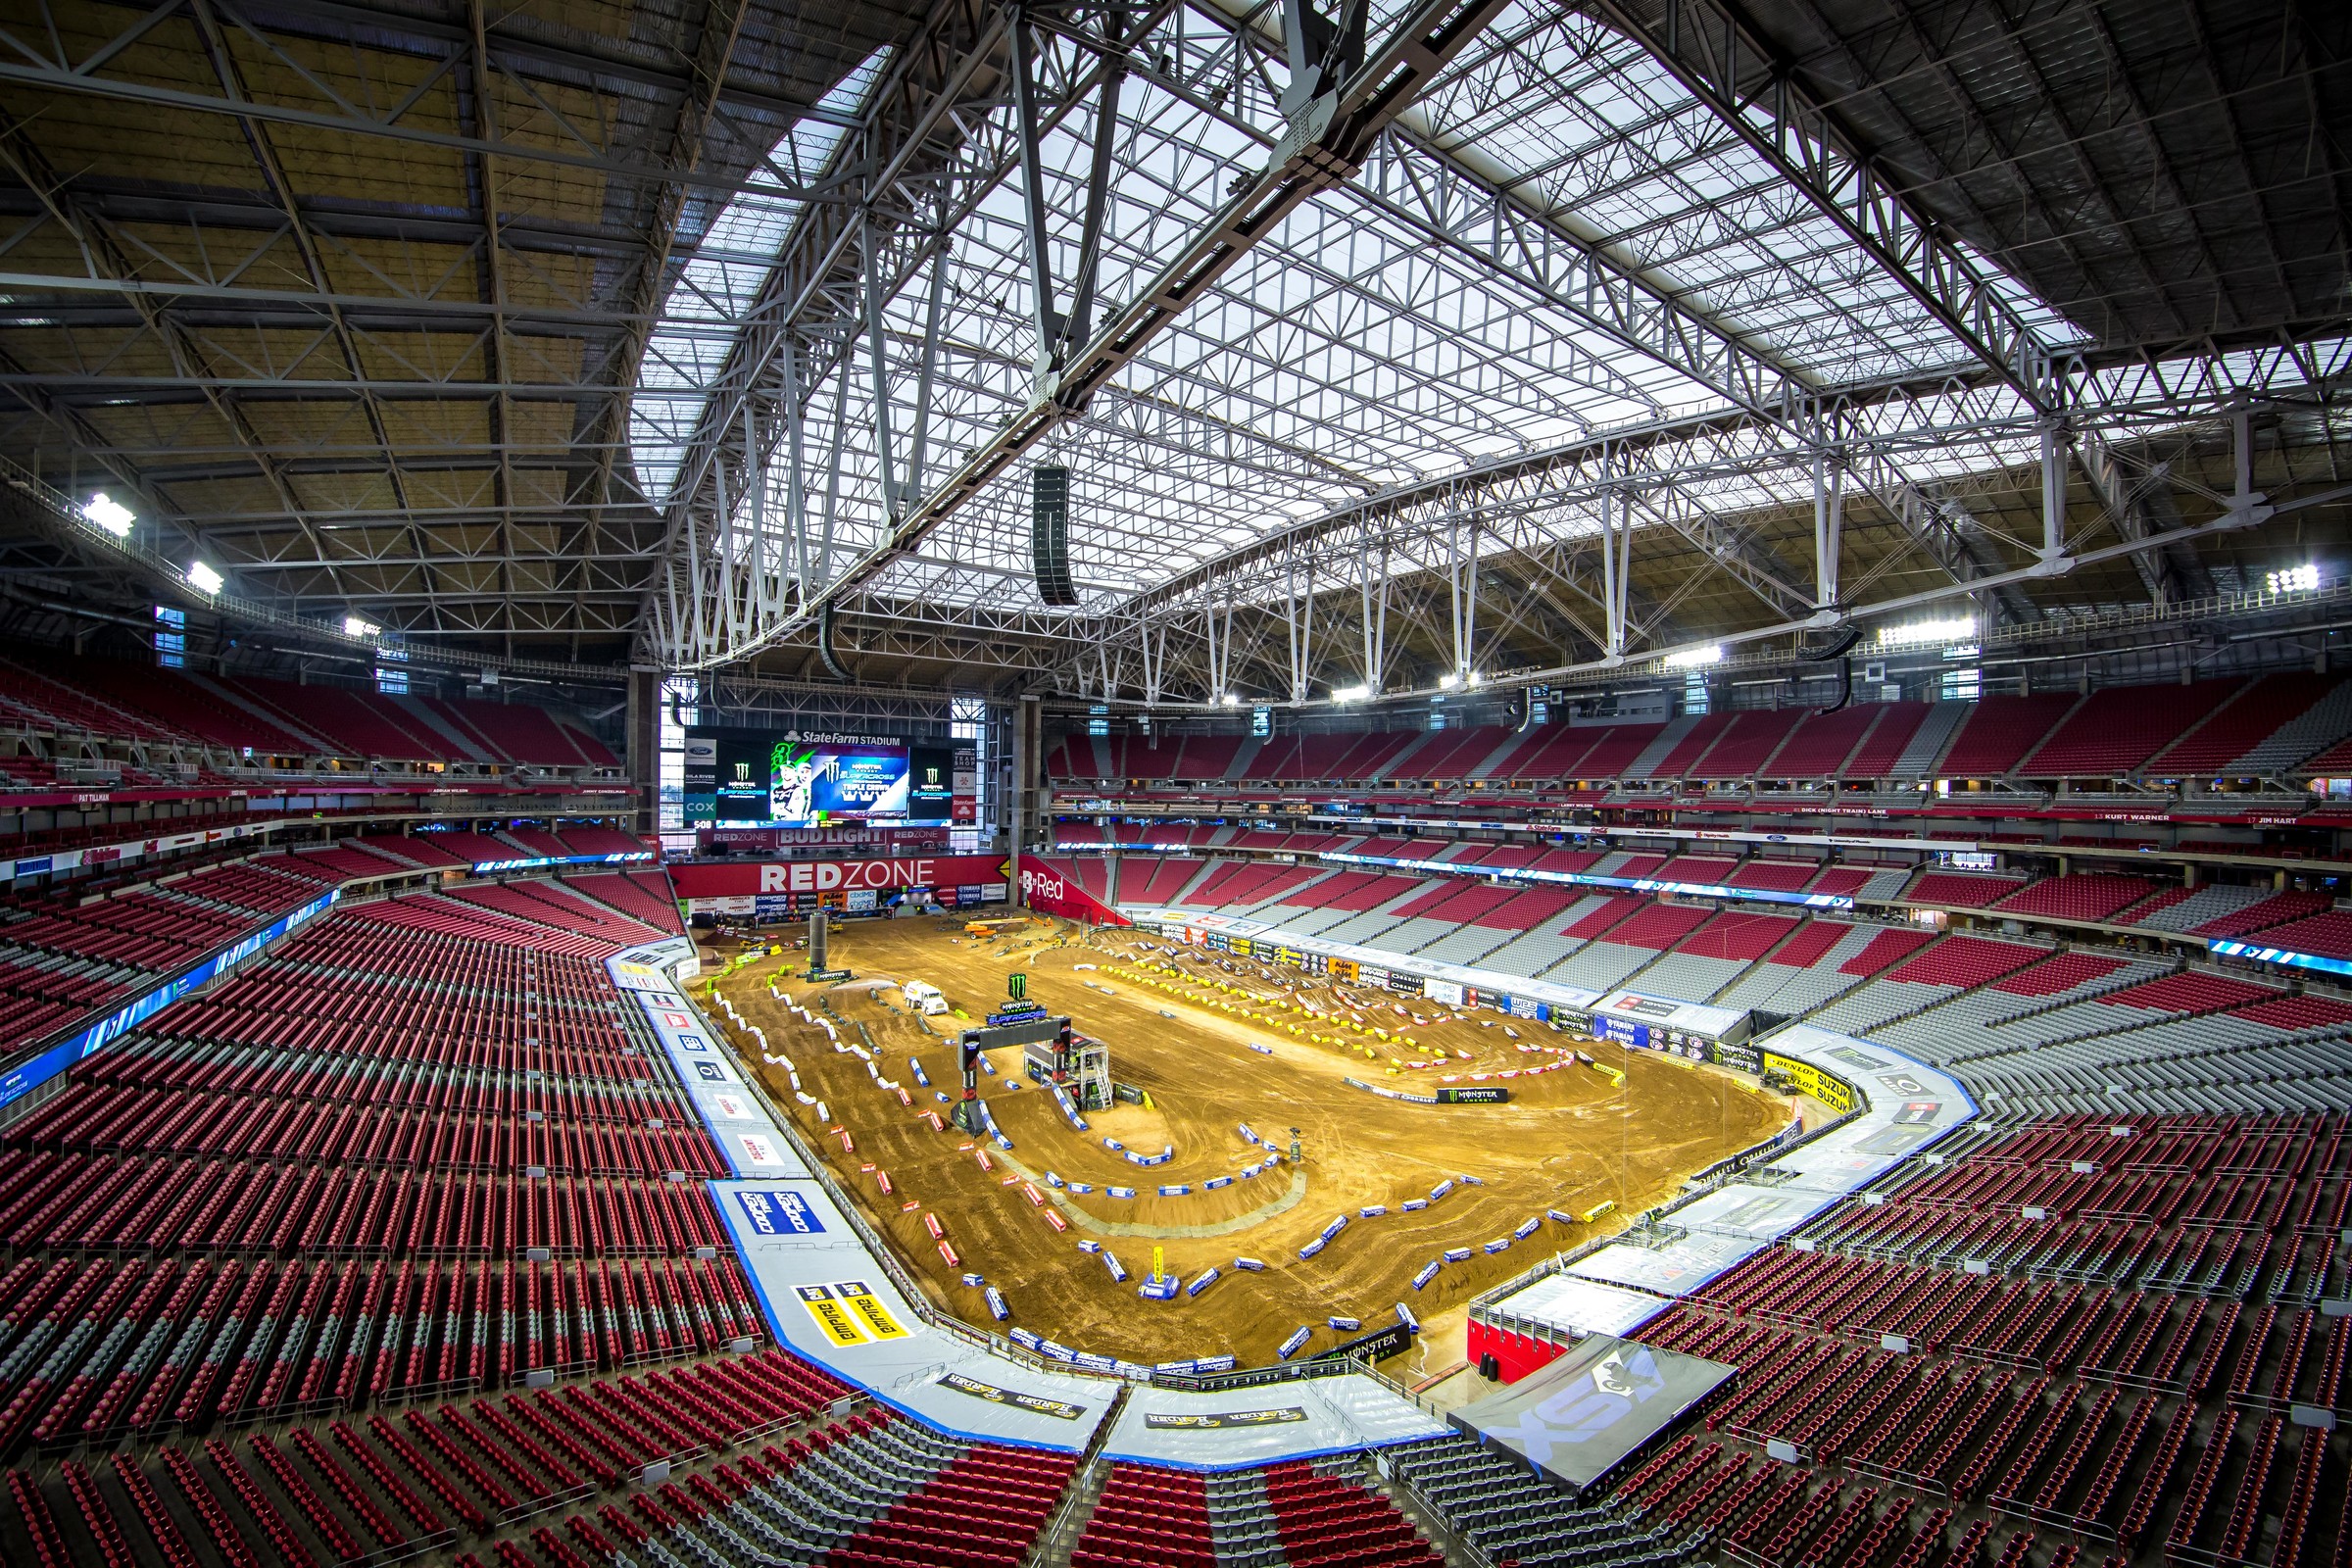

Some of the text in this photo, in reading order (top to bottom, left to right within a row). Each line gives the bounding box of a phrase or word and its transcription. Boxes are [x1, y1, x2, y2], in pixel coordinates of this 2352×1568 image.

[860, 736, 901, 746] STADIUM
[686, 803, 714, 811] COX
[694, 820, 712, 829] 5:08
[713, 832, 767, 842] REDZONE
[780, 828, 882, 844] BUD LIGHT
[894, 829, 938, 839] REDZONE
[760, 859, 935, 893] REDZONE
[1037, 873, 1063, 901] Red
[1335, 960, 1352, 970] KTM
[819, 971, 846, 980] MONSTER
[1335, 969, 1351, 978] KTM
[1002, 1001, 1033, 1010] MONSTER
[1511, 997, 1538, 1010] WPS
[1642, 1000, 1675, 1010] TOYOTA
[1559, 1008, 1589, 1019] MONSTER
[1635, 1005, 1667, 1016] TOYOTA
[1558, 1019, 1588, 1030] MONSTER
[1613, 1020, 1635, 1031] YAMAHA
[1613, 1031, 1635, 1042] YAMAHA
[1724, 1045, 1759, 1058] MONSTER
[1667, 1057, 1690, 1068] SUZUKI
[1723, 1056, 1757, 1070] MONSTER
[1776, 1059, 1815, 1076] DUNLOP
[1595, 1063, 1617, 1076] SUZUKI
[1817, 1087, 1848, 1113] SUZUK
[754, 1193, 773, 1214] TIRES
[787, 1193, 807, 1213] TIRES
[741, 1192, 775, 1234] COOPER
[773, 1192, 810, 1233] COOPER
[1592, 1203, 1613, 1218] SUZUKI
[805, 1286, 827, 1300] CAT
[843, 1283, 865, 1297] CAT
[1009, 1331, 1037, 1346] COOPER
[1343, 1333, 1397, 1359] MONSTER
[1041, 1346, 1071, 1361] COOPER
[1075, 1358, 1109, 1371] COOPER
[1197, 1361, 1233, 1372] COOPER
